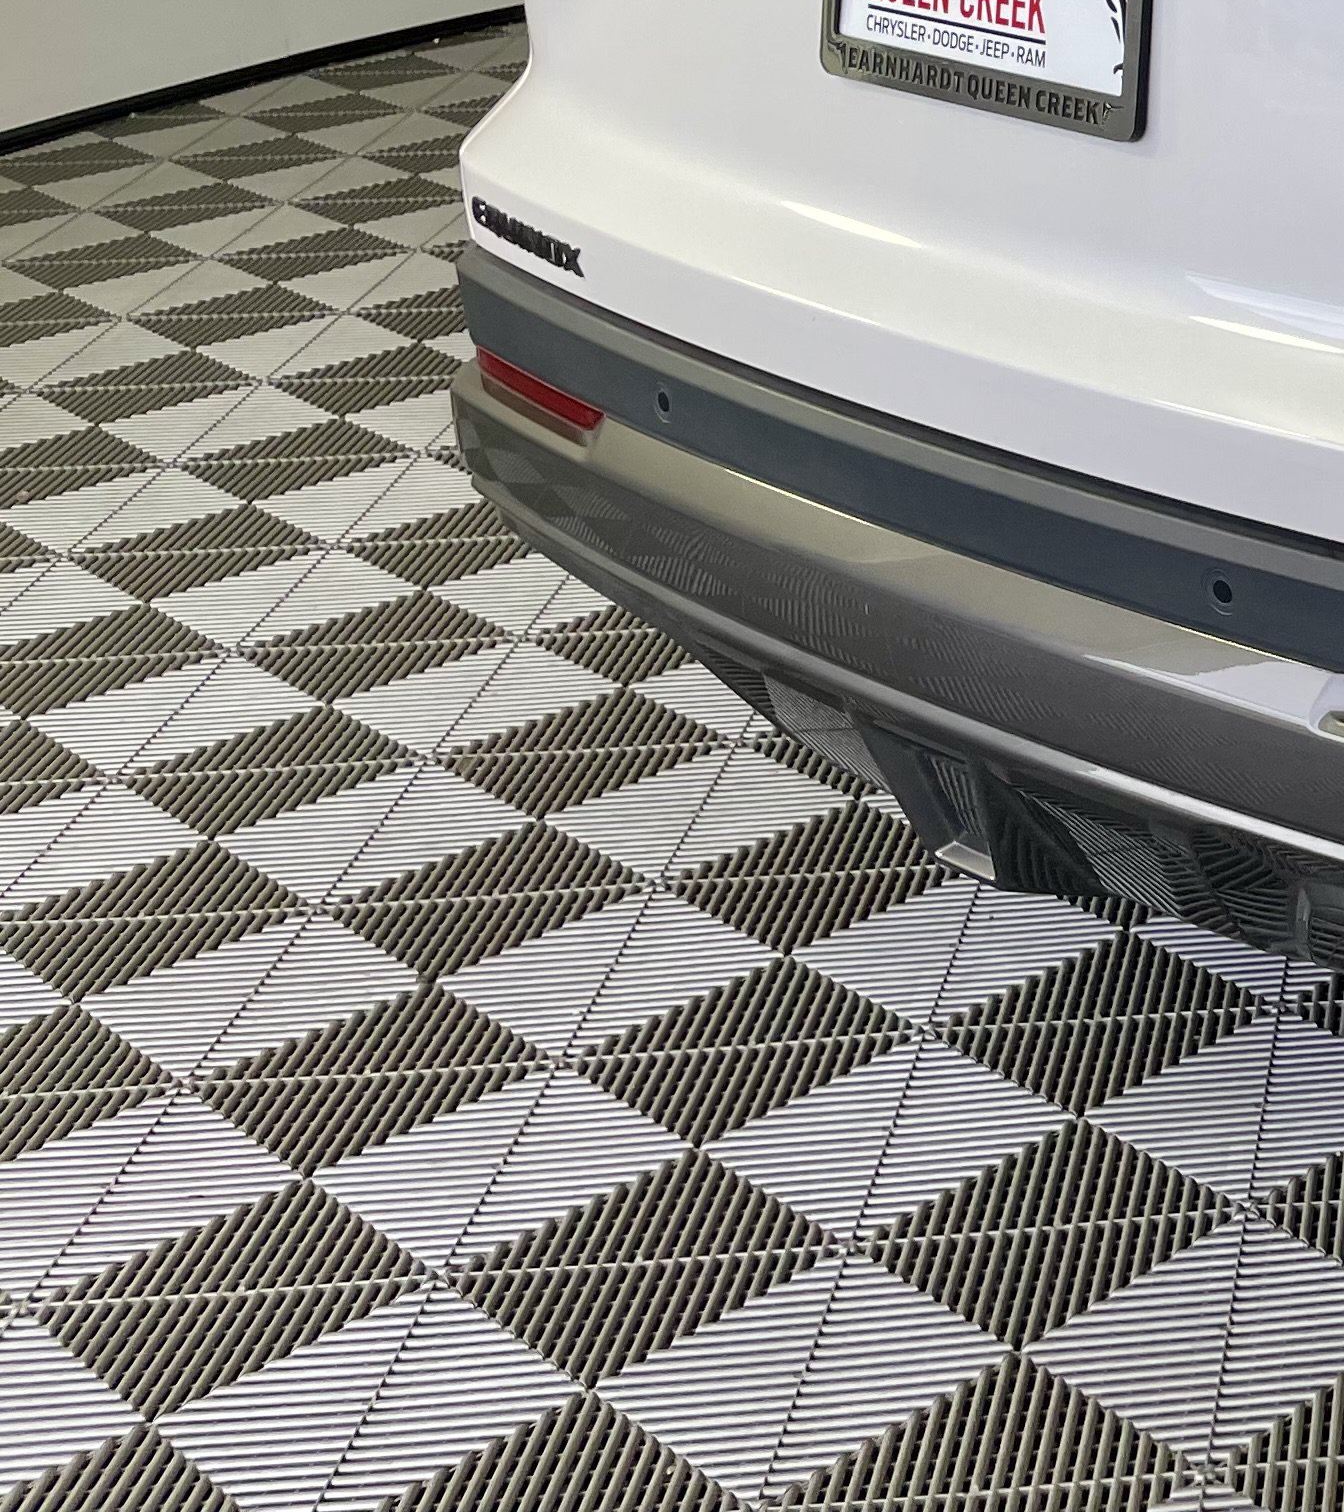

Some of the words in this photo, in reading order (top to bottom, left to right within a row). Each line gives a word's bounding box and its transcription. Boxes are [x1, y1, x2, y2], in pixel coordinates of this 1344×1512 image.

[866, 14, 926, 43] CHRYSLER
[932, 29, 974, 54] DODGE
[979, 38, 1010, 60] JEEP
[1017, 45, 1047, 67] RAM
[848, 46, 963, 94] EARNHARDT
[967, 75, 1031, 110] QUEEN
[1035, 89, 1100, 126] CREEK
